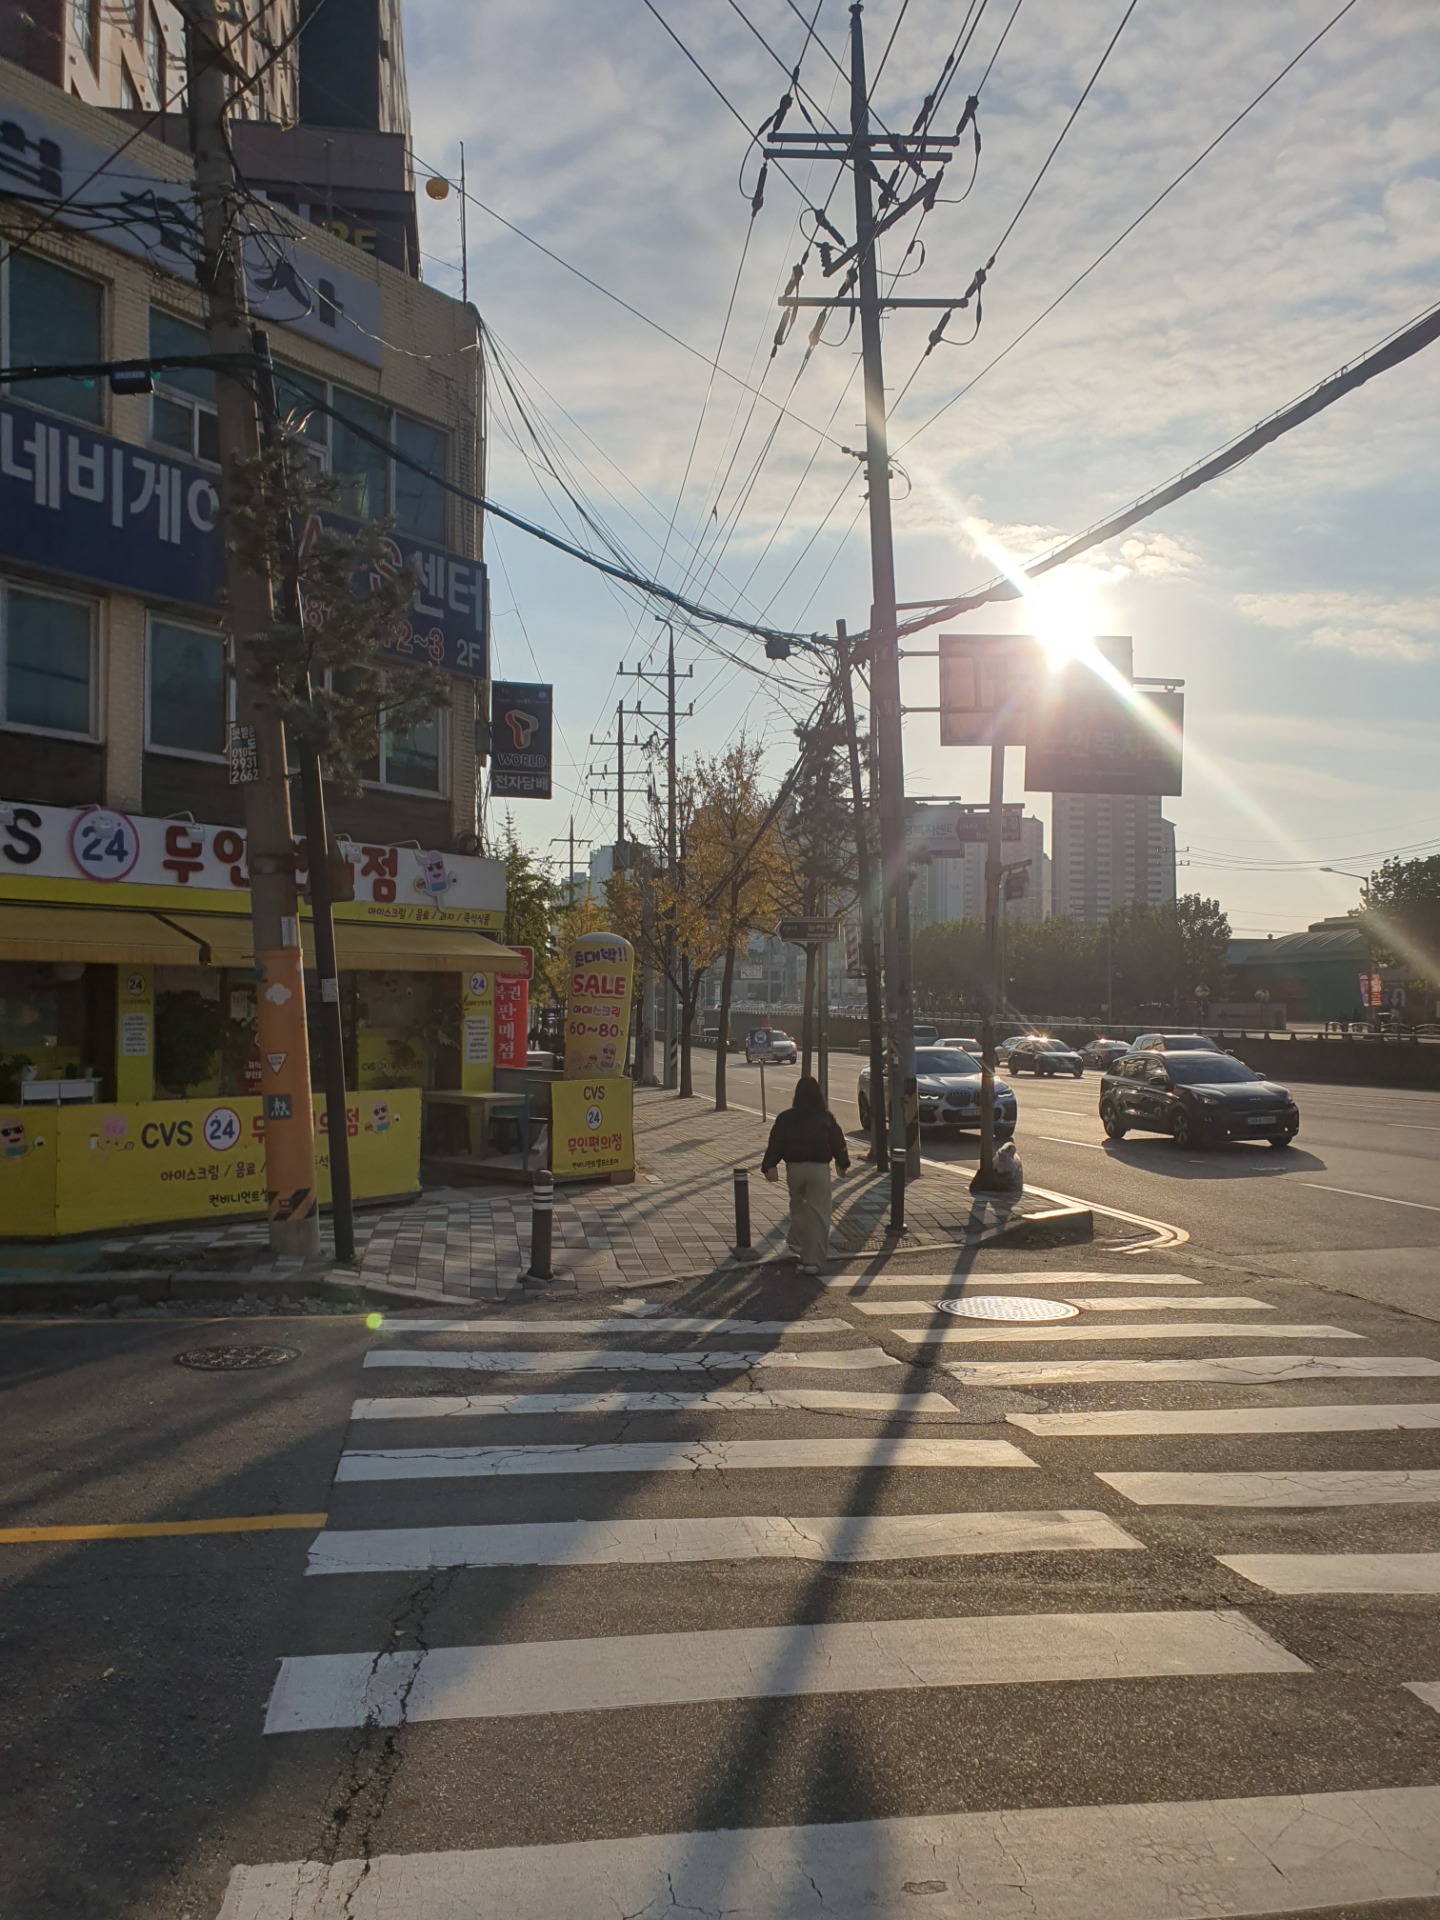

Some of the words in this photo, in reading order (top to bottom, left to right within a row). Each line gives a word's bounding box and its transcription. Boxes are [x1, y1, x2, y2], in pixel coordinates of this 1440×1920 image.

[457, 638, 481, 667] 2F
[232, 747, 249, 758] 010
[498, 753, 546, 768] WORLD
[232, 756, 257, 770] 9931
[231, 769, 259, 782] 2662
[495, 774, 549, 791] 전자담배
[82, 824, 128, 862] 24
[163, 825, 398, 903] 무인점
[368, 906, 407, 920] 아이스크림
[129, 979, 142, 990] 24
[472, 977, 485, 990] 24
[573, 974, 626, 996] SALE
[573, 1004, 621, 1018] 아이스크림
[498, 1003, 517, 1060] 판매점
[583, 1085, 605, 1101] CVS
[588, 1112, 600, 1124] 24
[141, 1120, 193, 1149] CVS
[209, 1119, 235, 1141] 24
[568, 1133, 622, 1155] 무인편의점
[160, 1164, 219, 1181] 아이스크림
[234, 1160, 255, 1179] 음료
